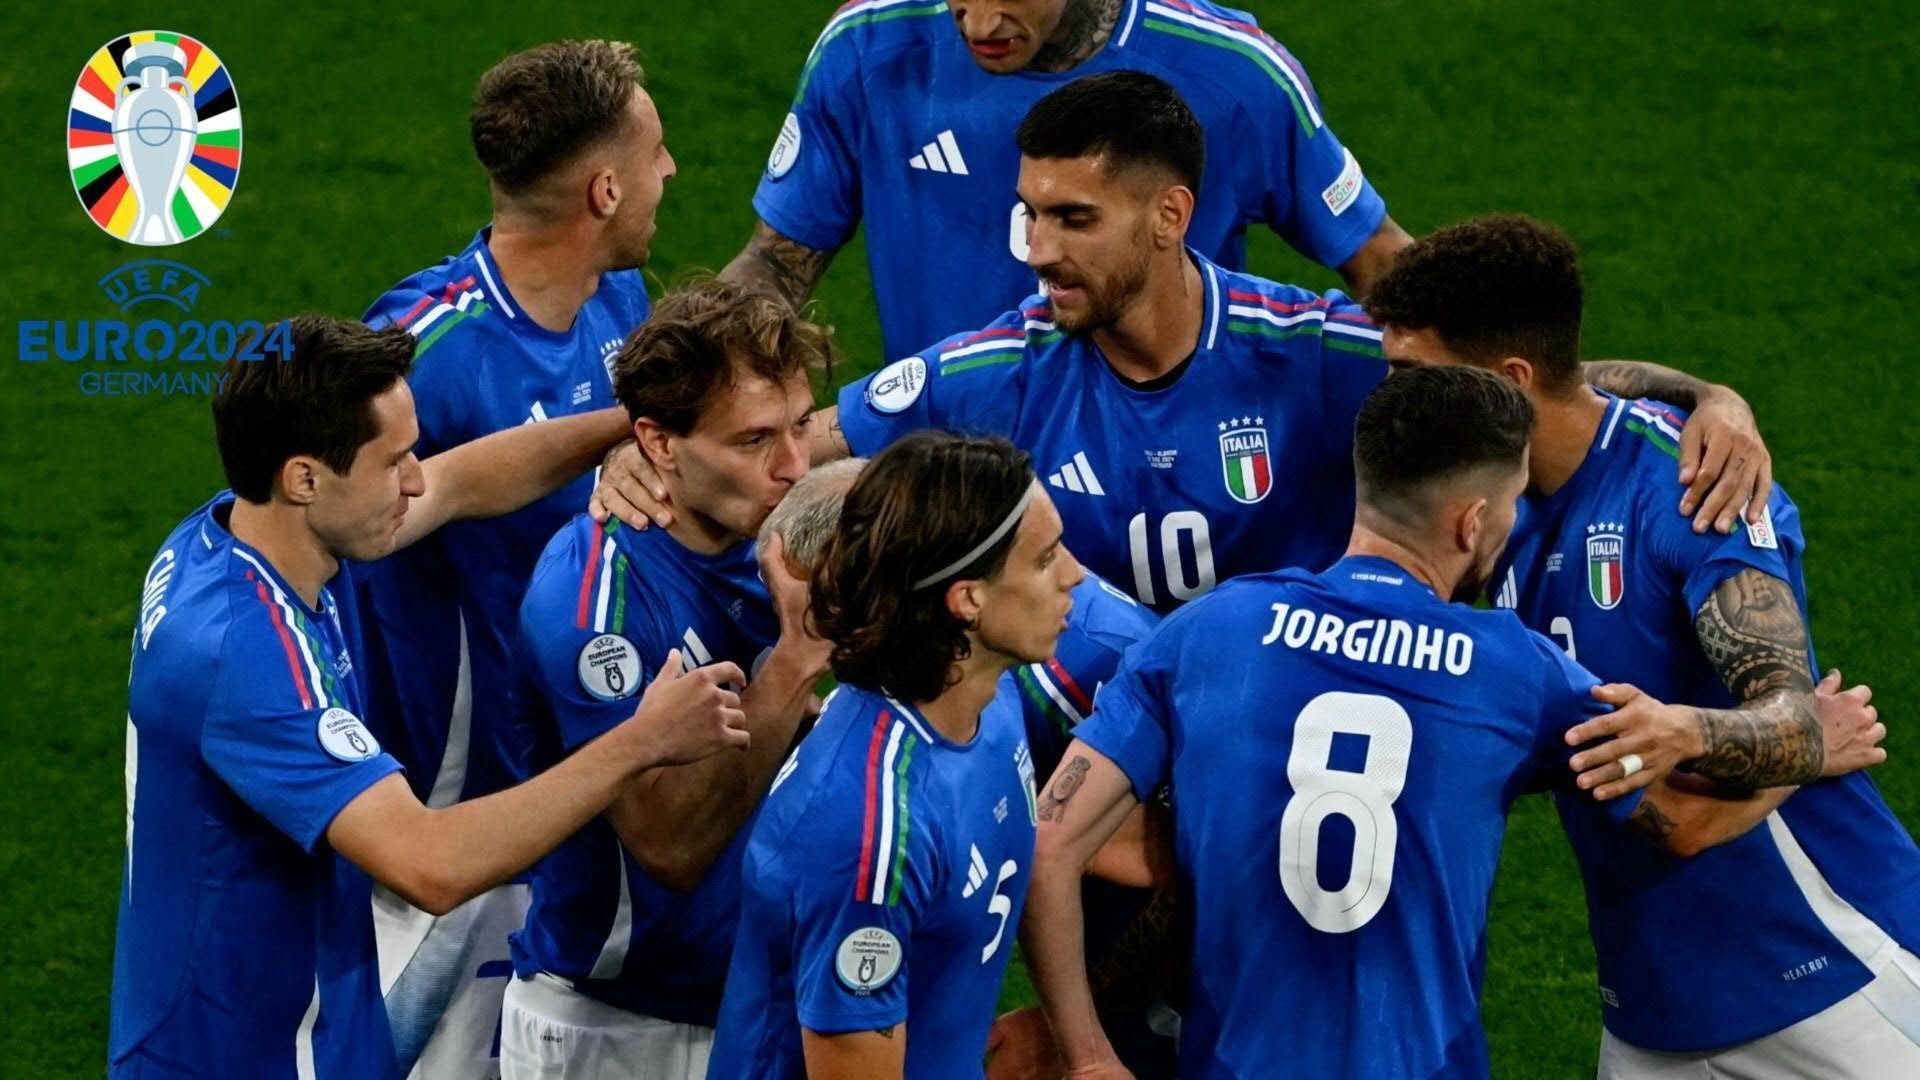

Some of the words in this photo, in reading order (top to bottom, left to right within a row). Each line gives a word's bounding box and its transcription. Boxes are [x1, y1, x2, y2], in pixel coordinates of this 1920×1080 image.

[1224, 434, 1264, 453] ITALIA
[1591, 541, 1620, 556] ITALIA
[1129, 511, 1217, 605] 10
[1262, 603, 1474, 676] JORGINHO
[588, 646, 626, 660] EUROPEAN
[590, 653, 628, 667] CHAMPIONS
[1279, 691, 1413, 934] 8
[982, 859, 1018, 965] 5
[852, 940, 891, 948] EUROPEAN
[852, 947, 890, 955] CHAMPIONS
